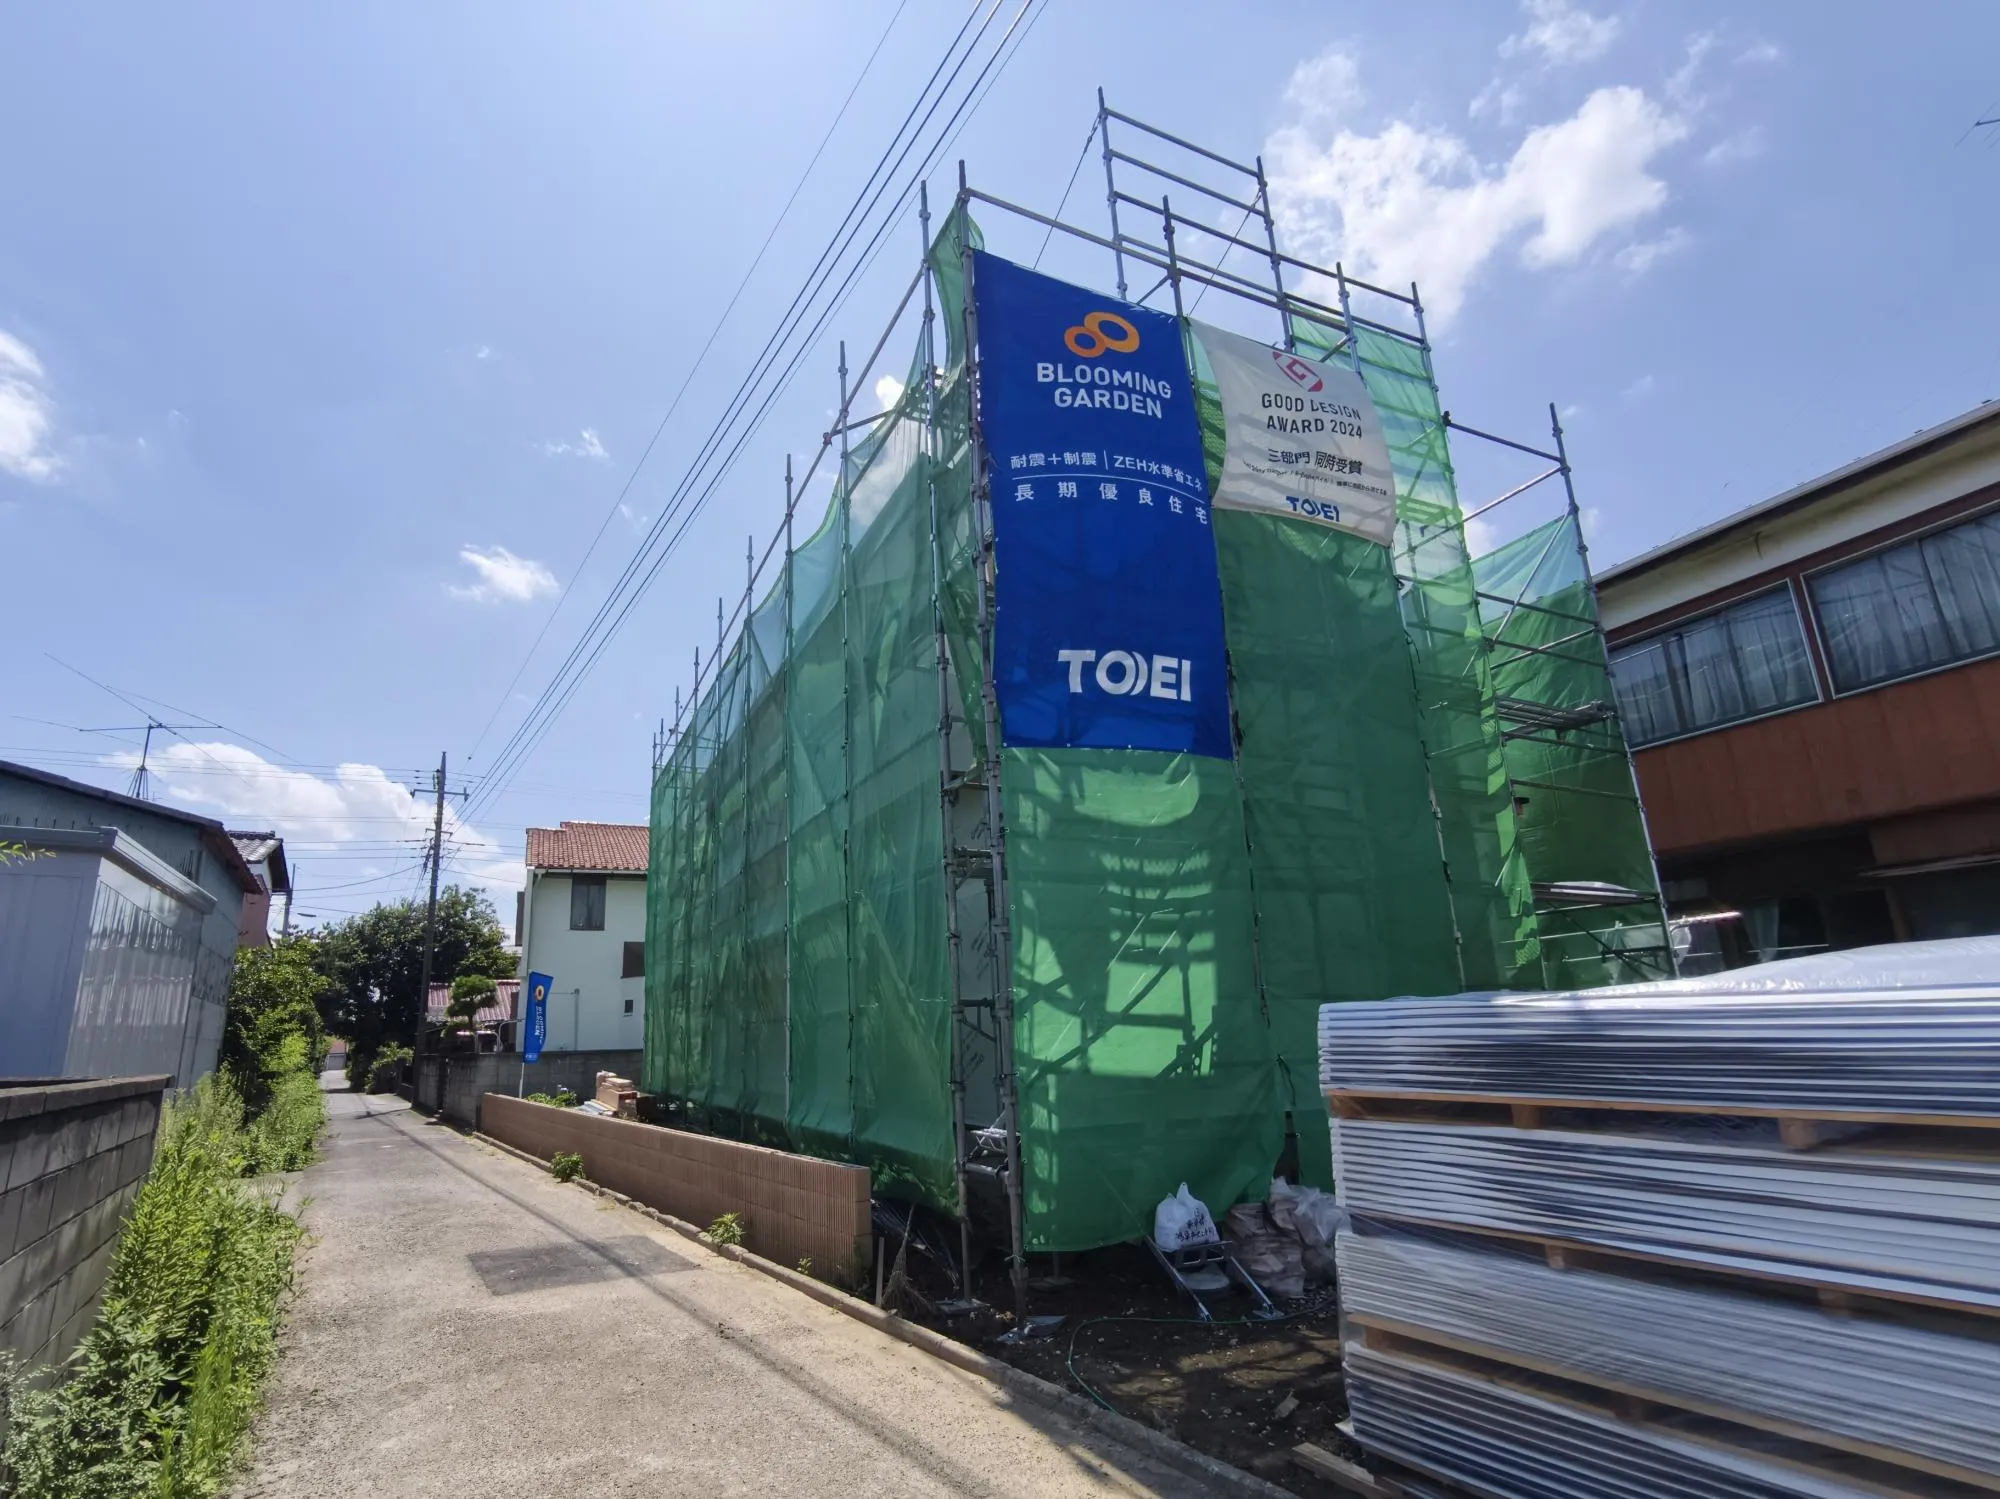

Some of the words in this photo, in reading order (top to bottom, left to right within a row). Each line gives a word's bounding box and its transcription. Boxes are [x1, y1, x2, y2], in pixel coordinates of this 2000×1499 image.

[1036, 362, 1172, 399] BLOOMING
[1054, 387, 1162, 419] GARDEN
[1261, 393, 1304, 412] GOOD
[1266, 415, 1325, 434] AWARD
[1330, 419, 1363, 440] 2024
